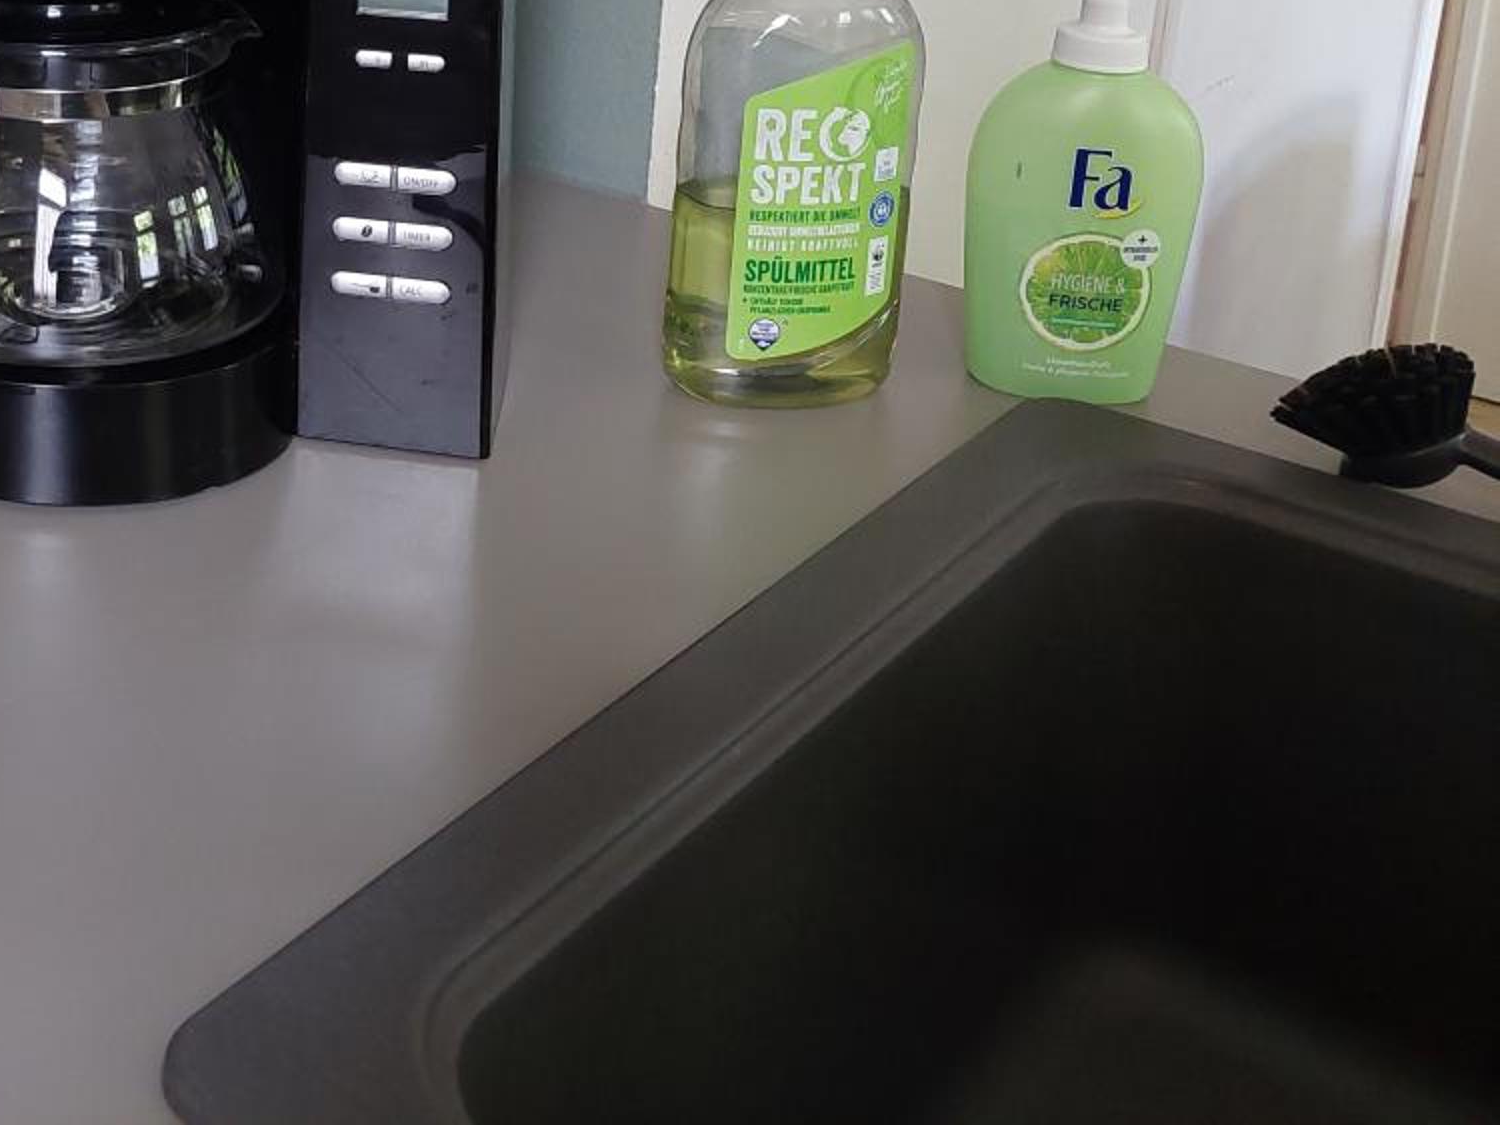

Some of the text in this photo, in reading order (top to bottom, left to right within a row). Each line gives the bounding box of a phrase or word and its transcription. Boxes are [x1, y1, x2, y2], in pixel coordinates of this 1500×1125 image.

[750, 163, 866, 205] SPEKT
[1069, 148, 1132, 211] Fa
[744, 255, 856, 284] SPÜLMITTEL
[1051, 273, 1112, 293] HYGIENE
[1048, 293, 1125, 313] FRISCHE
